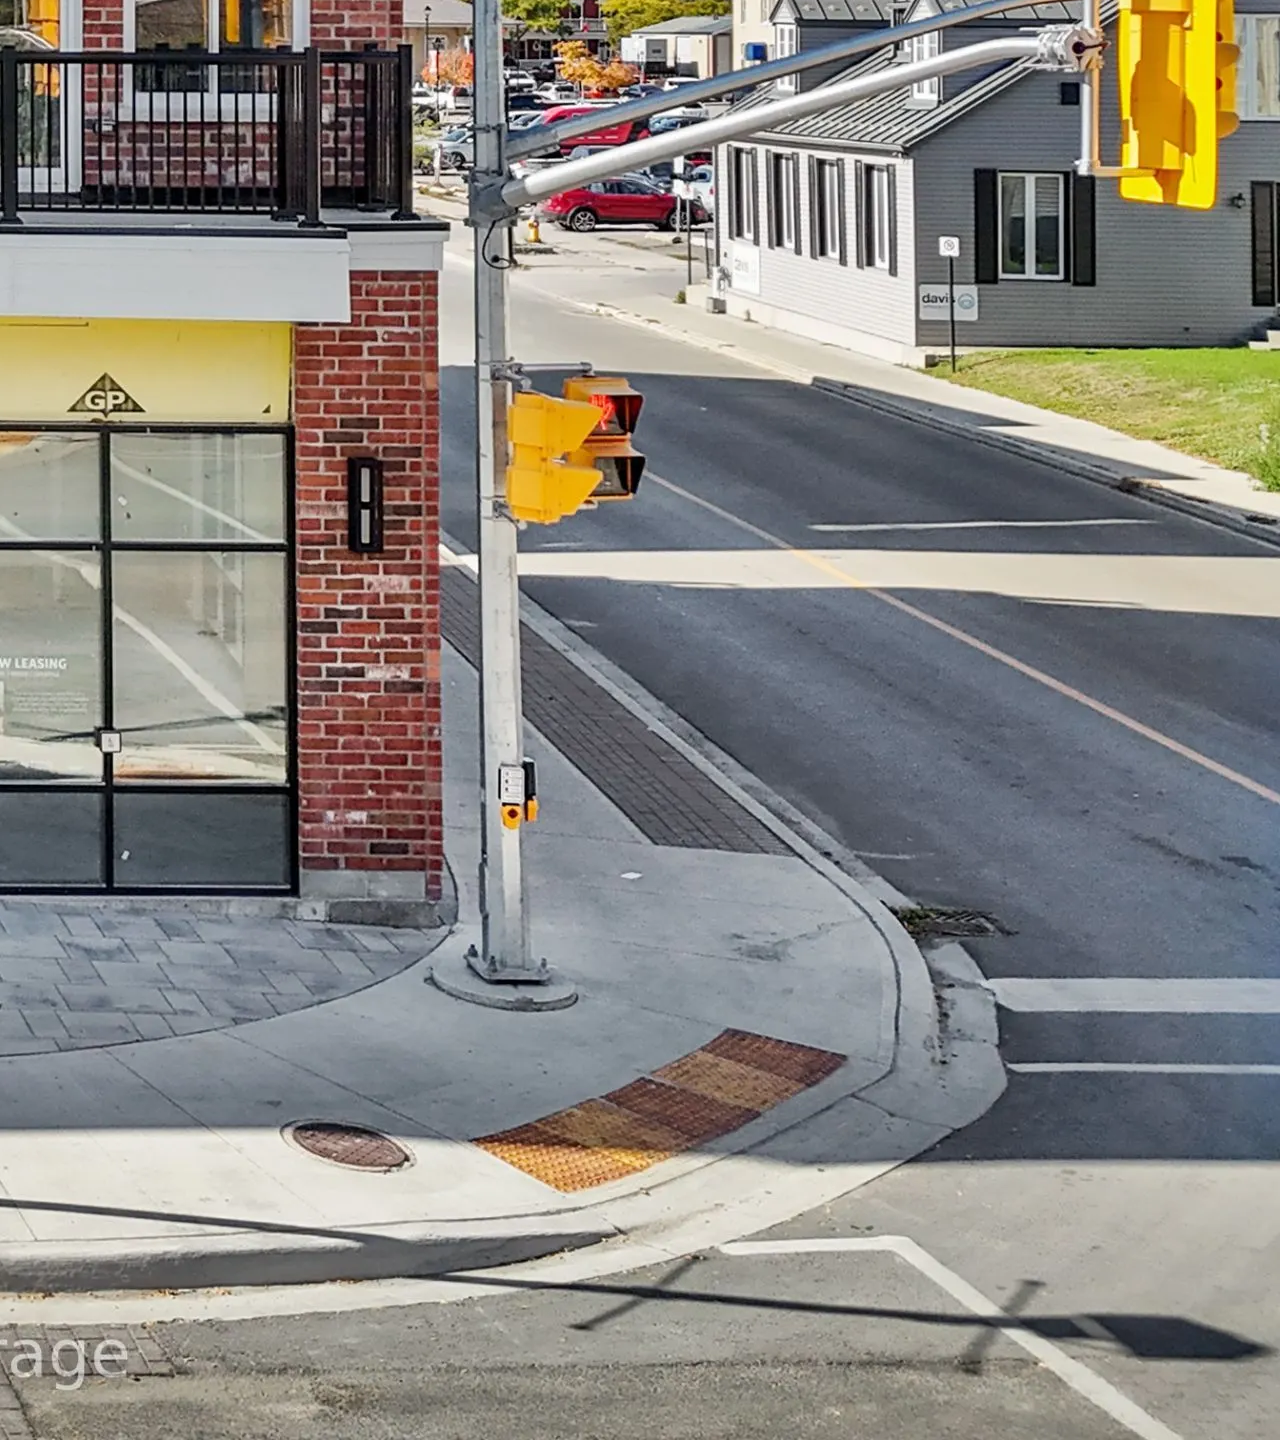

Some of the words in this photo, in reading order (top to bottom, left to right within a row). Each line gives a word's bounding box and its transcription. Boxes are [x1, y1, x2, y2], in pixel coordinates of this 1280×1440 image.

[922, 293, 956, 304] davi
[84, 390, 126, 411] GP
[14, 657, 67, 670] LEASING
